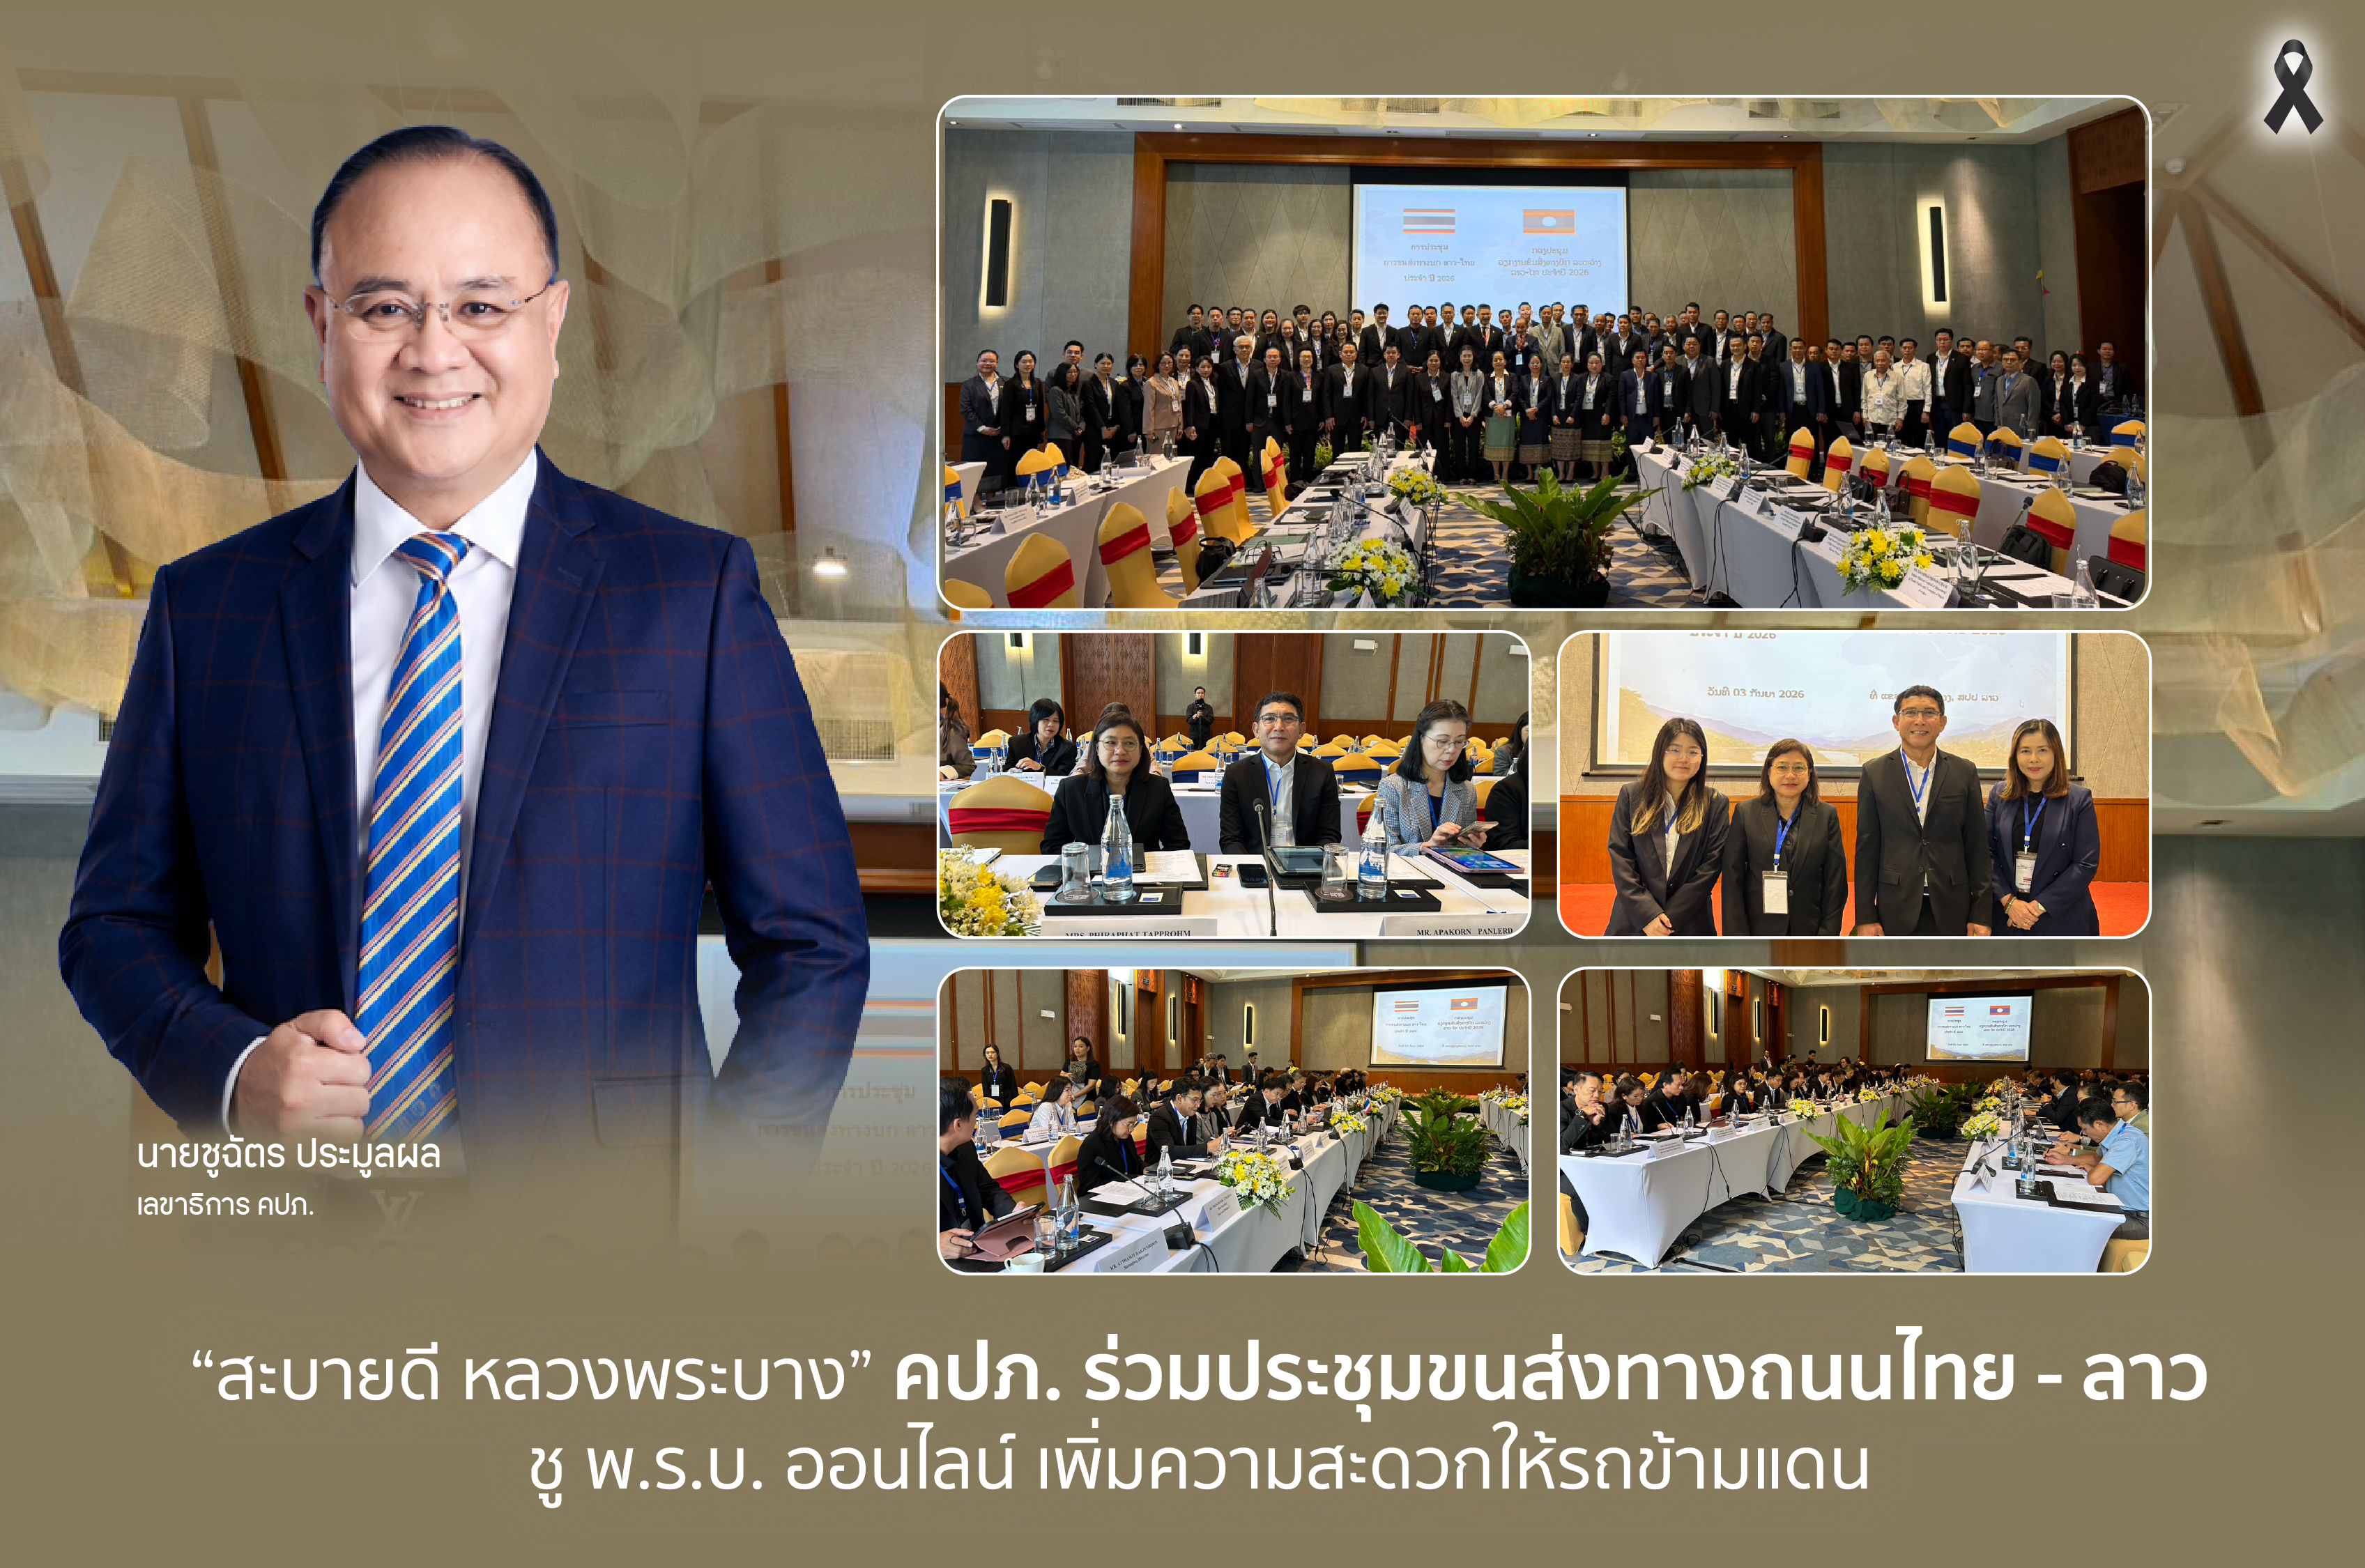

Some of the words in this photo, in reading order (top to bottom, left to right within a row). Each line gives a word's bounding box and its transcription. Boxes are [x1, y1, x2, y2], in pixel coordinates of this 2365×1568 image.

[1733, 689, 1747, 697] 03
[1779, 690, 1805, 698] 2026
[1123, 1259, 1138, 1270] Managing
[1138, 1253, 1149, 1263] Director
